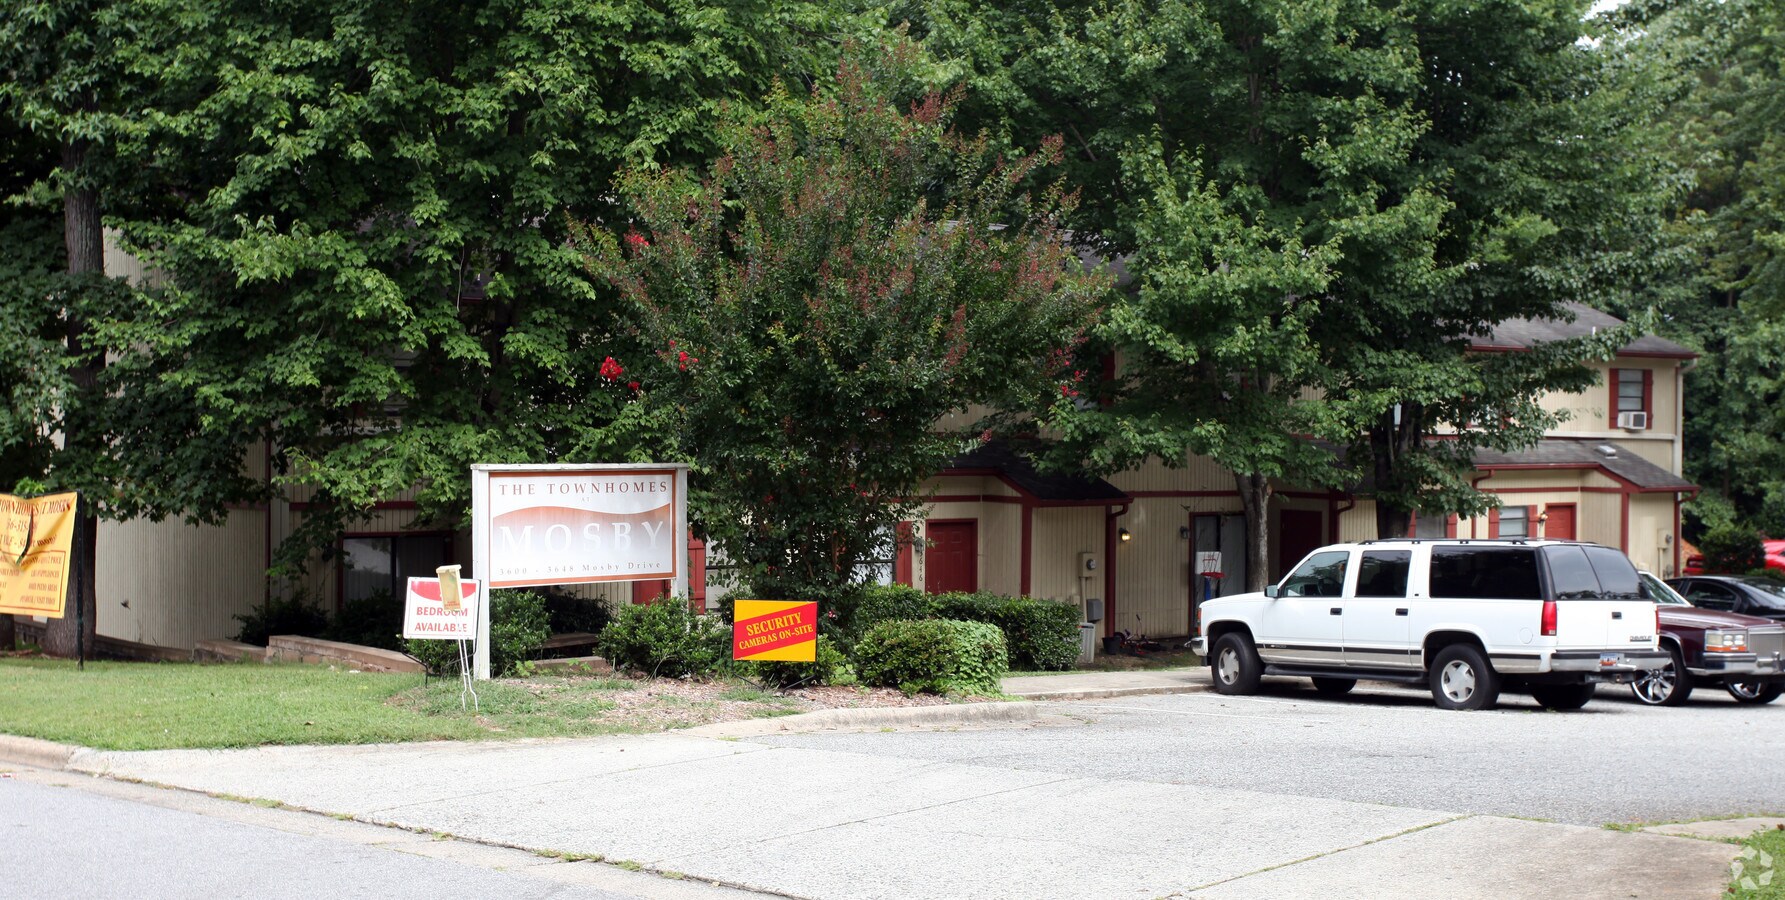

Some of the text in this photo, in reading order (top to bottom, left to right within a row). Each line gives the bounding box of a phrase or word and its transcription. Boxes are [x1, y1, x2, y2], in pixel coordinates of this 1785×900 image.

[499, 481, 667, 495] THE TOWNHOMES
[499, 521, 664, 554] MOSBY
[499, 567, 527, 576] 3600
[547, 565, 574, 574] 3648
[582, 563, 619, 572] Mosby
[628, 561, 661, 570] Drive
[746, 612, 802, 636] SECURITY
[739, 624, 813, 649] CAMERAS ON-SITE
